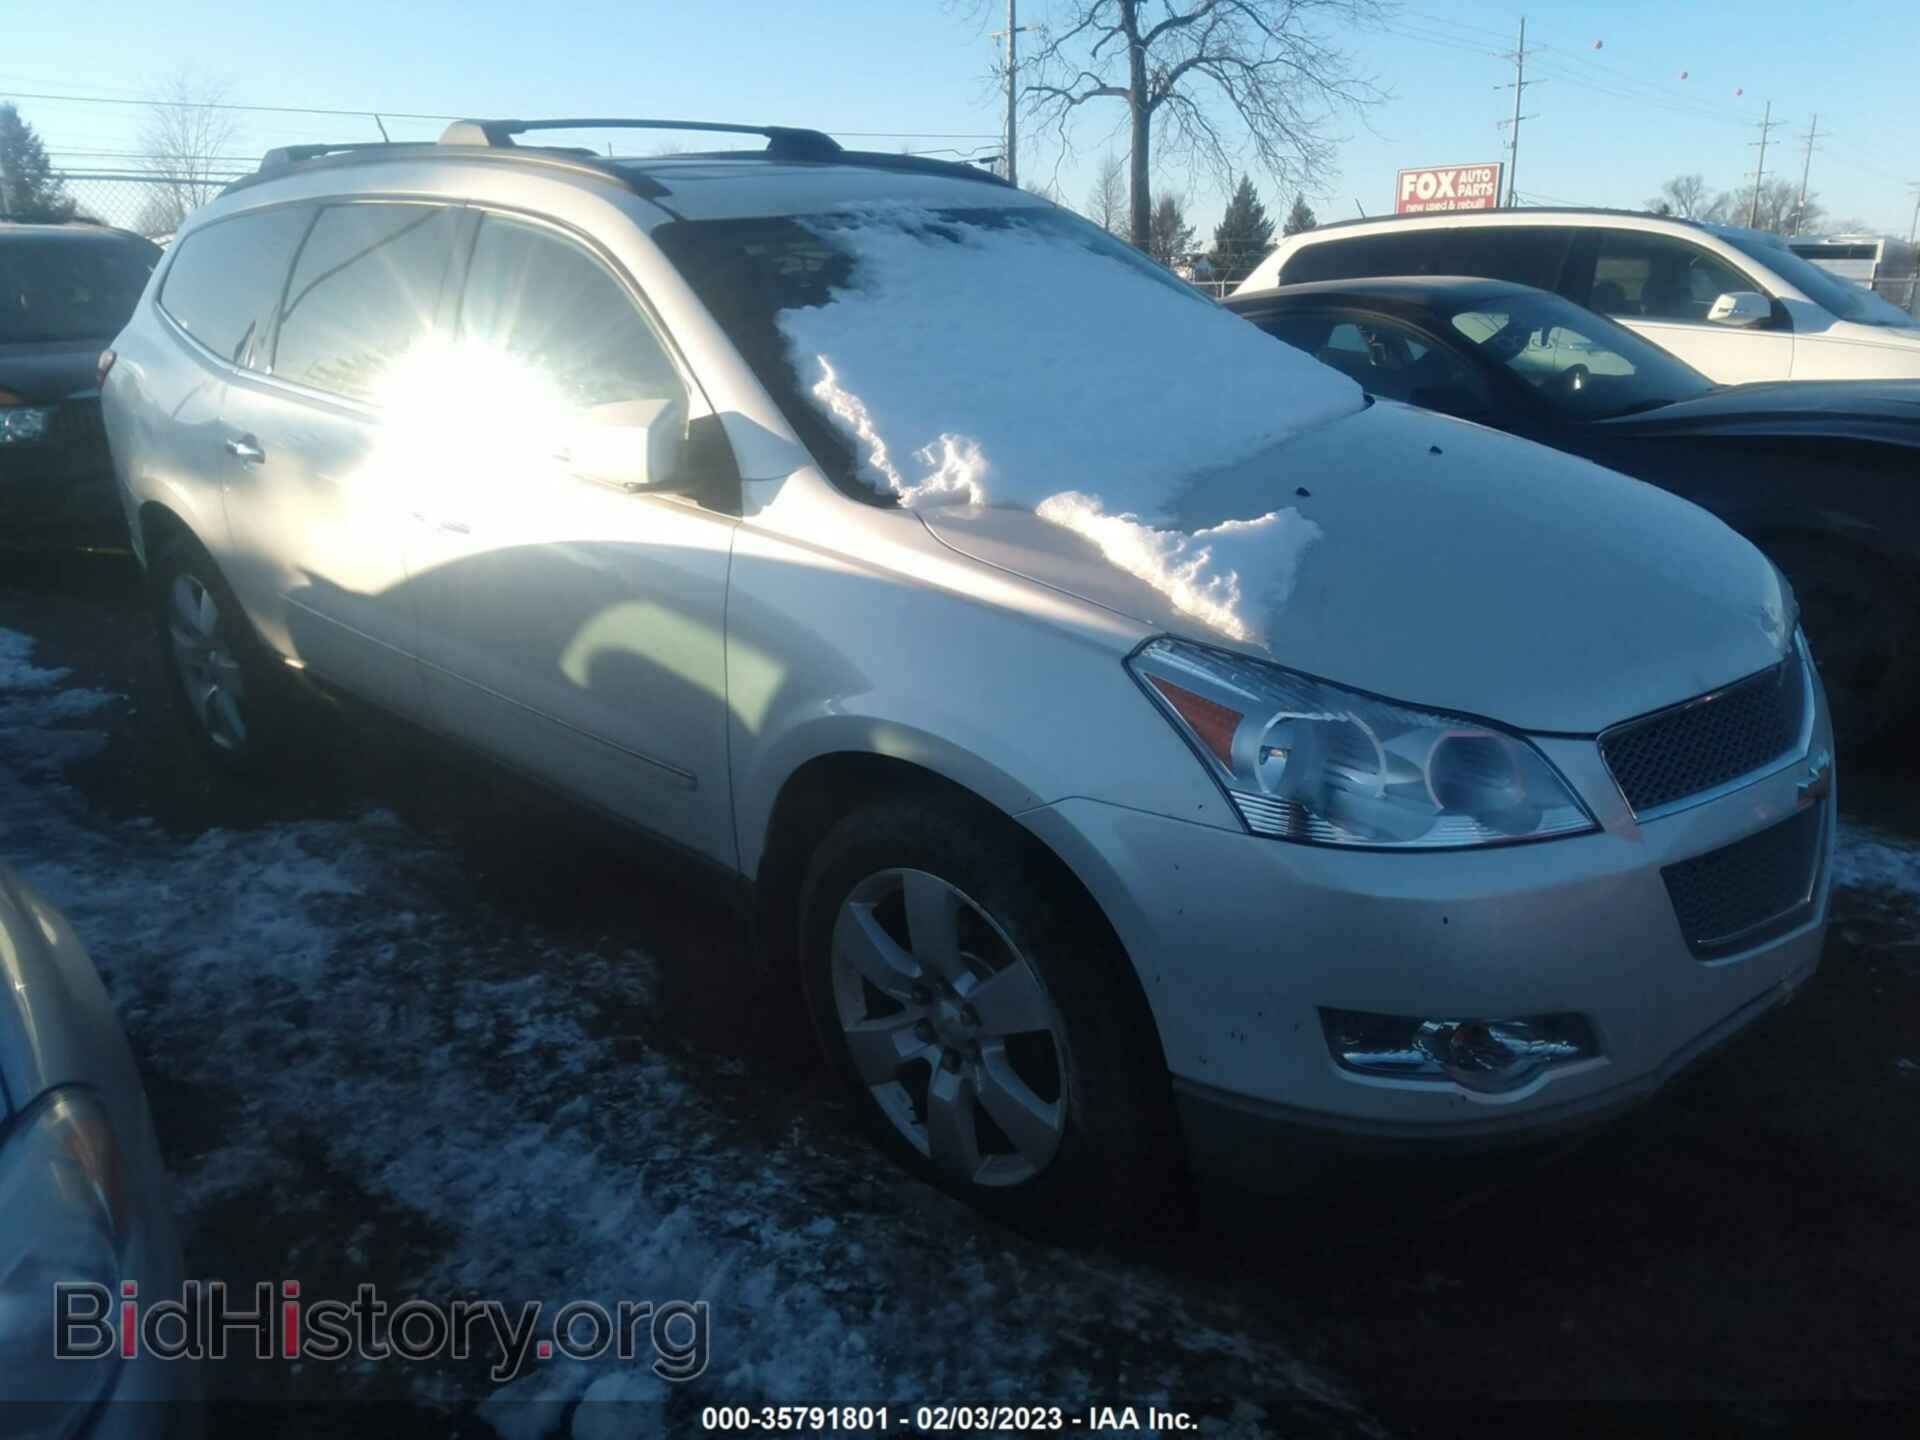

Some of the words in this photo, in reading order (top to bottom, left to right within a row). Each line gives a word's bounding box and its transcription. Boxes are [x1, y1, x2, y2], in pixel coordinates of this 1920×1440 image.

[1459, 168, 1491, 182] AUTO
[1401, 171, 1457, 200] FOX
[1457, 183, 1493, 197] PARTS
